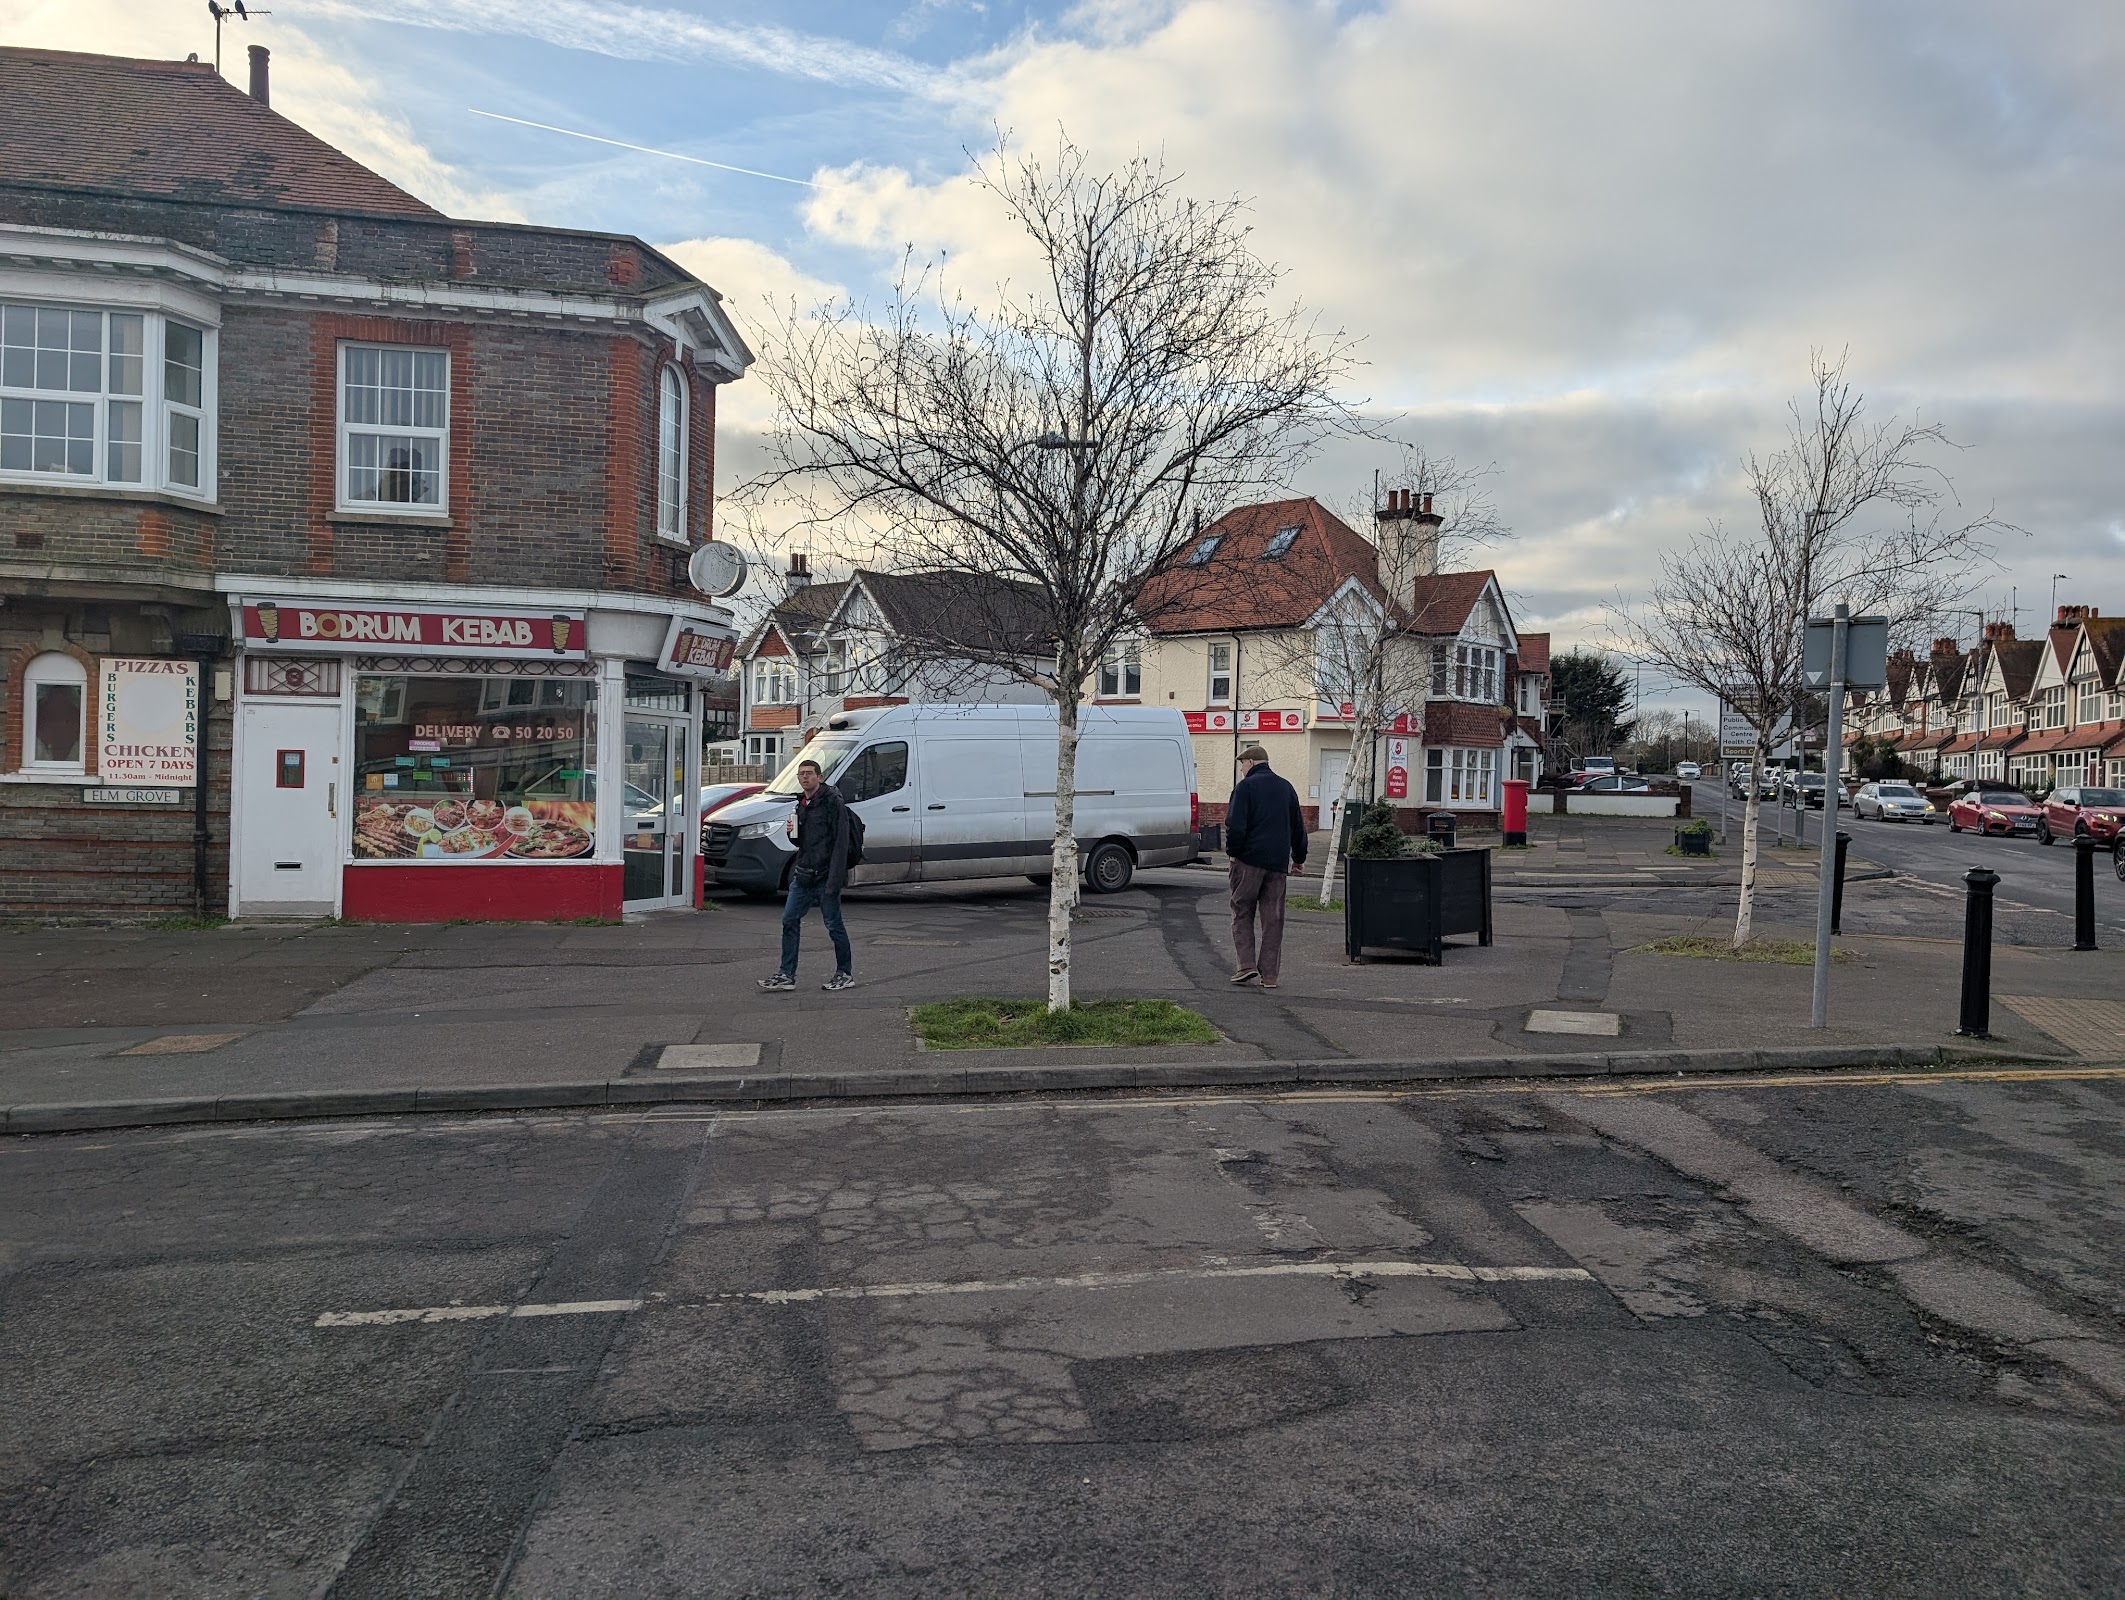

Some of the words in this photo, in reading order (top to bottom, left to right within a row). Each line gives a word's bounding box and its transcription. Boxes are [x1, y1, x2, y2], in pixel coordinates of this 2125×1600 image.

[299, 611, 421, 641] BODRUM
[442, 617, 534, 645] KEBAB
[691, 635, 722, 652] BODRUM
[687, 647, 717, 666] KEBAB
[114, 660, 189, 675] PIZZAS
[106, 673, 117, 742] BURGERS
[184, 676, 196, 744] KEBABS
[415, 724, 483, 738] DELIVERY
[515, 726, 532, 739] 50
[536, 726, 553, 739] 20
[557, 727, 574, 739] 50
[104, 744, 195, 758] CHICKEN
[1725, 747, 1747, 755] Sports
[107, 759, 143, 769] OPEN
[149, 760, 156, 769] 7
[161, 760, 194, 770] DAYS
[154, 773, 192, 782] Midnight
[92, 790, 119, 801] ELM
[126, 790, 171, 802] GROVE
